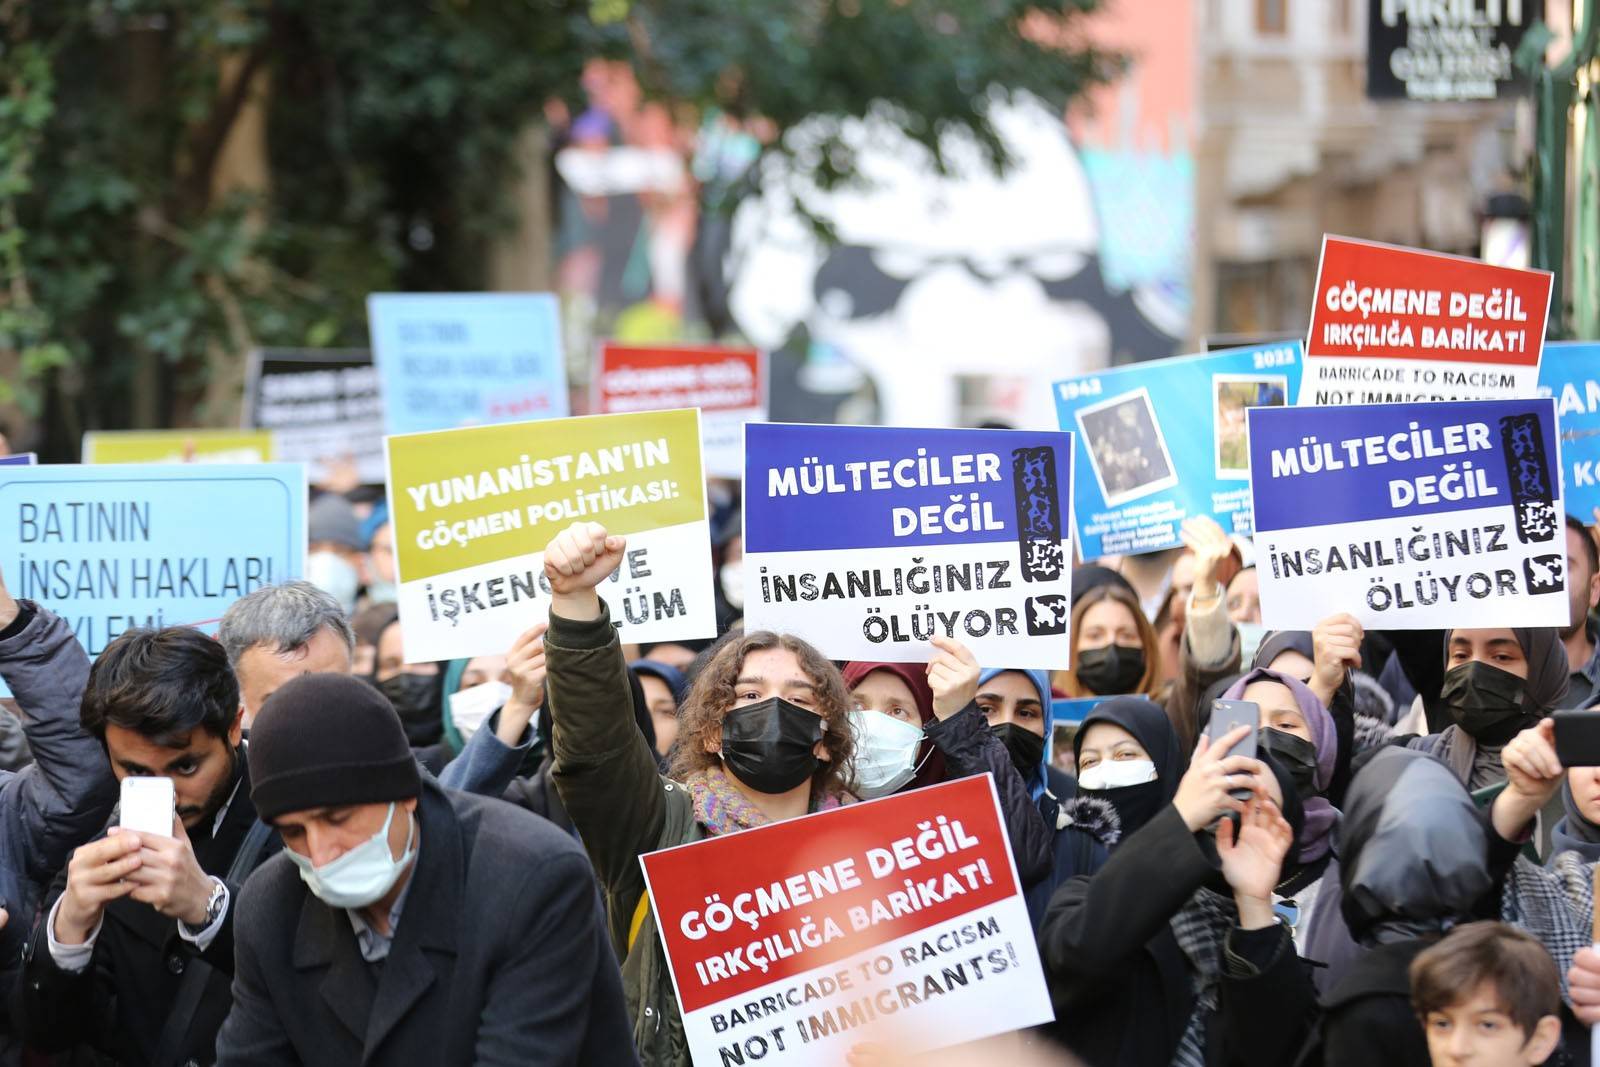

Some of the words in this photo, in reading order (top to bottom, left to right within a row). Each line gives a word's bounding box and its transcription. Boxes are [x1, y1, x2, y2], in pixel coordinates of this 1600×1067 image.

[1325, 280, 1441, 319] GÖÇMENE
[1449, 288, 1527, 321] DEĞİL
[1323, 319, 1414, 352] IRKÇILIĞA
[1315, 390, 1354, 405] NOT
[1319, 365, 1404, 383] BARRICADE
[1413, 367, 1436, 384] TO
[1443, 369, 1515, 388] RACISM
[768, 447, 1002, 497] MÜLTECİLER
[1271, 421, 1492, 478] MÜLTECİLER
[407, 438, 670, 512] YUNANİSTAN'IN
[1389, 461, 1498, 508] DEĞİL
[19, 502, 151, 543] BATININ
[417, 508, 522, 550] GÖÇMEN
[527, 479, 680, 526] POLİTİKASI:
[892, 493, 1004, 537] DEĞİL
[1269, 524, 1508, 579] İNSANLIĞINIZ
[19, 553, 119, 600] İNSAN
[131, 557, 272, 598] HAKLARI
[759, 556, 1012, 603] İNSANLIĞINIZ
[1365, 570, 1519, 612] ÖLÜYOR
[862, 604, 1019, 644] ÖLÜYOR
[680, 857, 862, 941] GÖÇMENE
[865, 815, 980, 880] DEĞİL
[695, 916, 845, 988] IRKÇILIĞA
[847, 858, 993, 933] BARİKAT!
[710, 970, 856, 1034] BARRICADE
[858, 955, 894, 981] TO
[900, 916, 1001, 968] RACISM
[718, 1026, 786, 1067] NOT
[797, 941, 1020, 1044] IMMIGRANTS!
